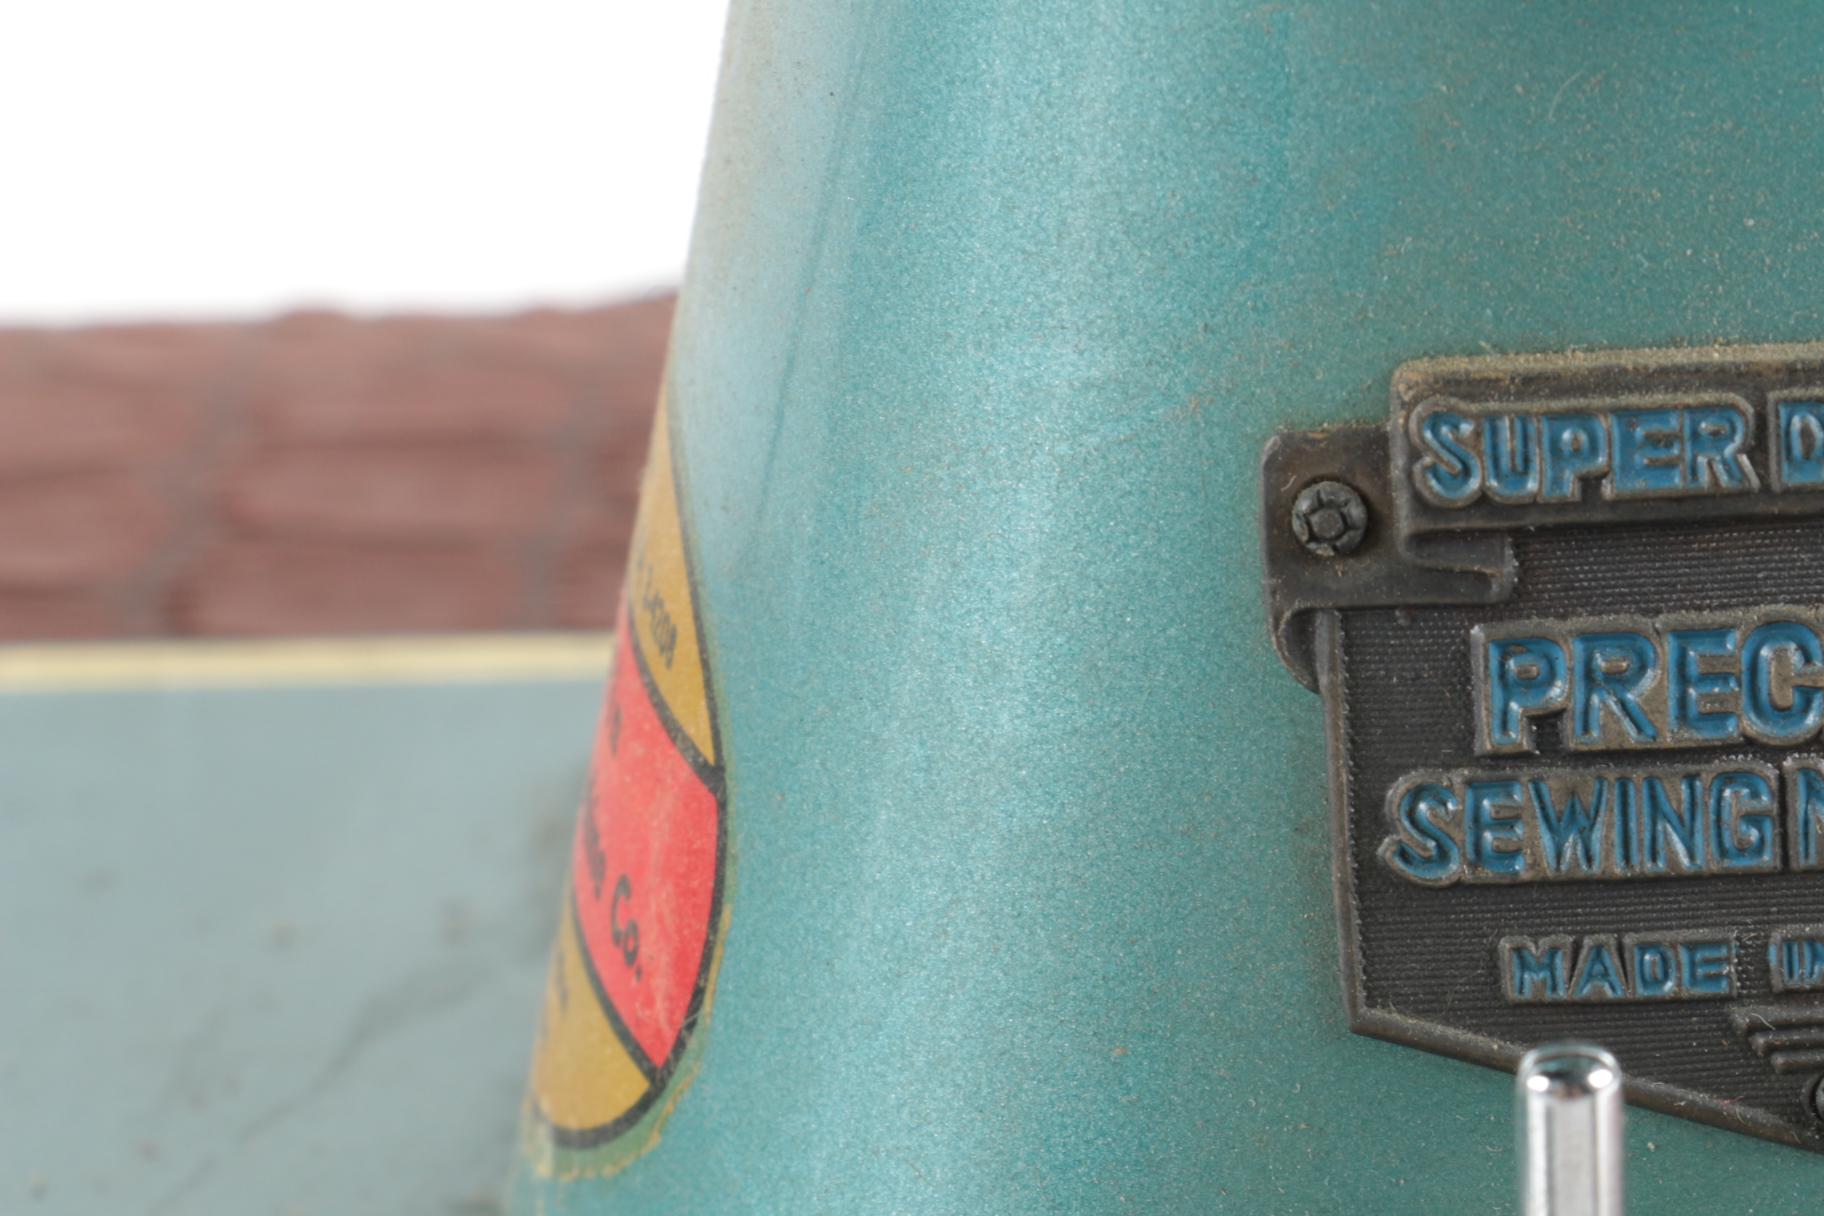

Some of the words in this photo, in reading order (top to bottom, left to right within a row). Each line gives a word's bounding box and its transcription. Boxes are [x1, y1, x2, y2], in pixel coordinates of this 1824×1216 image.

[1417, 395, 1762, 504] SUPER
[1391, 770, 1776, 880] SEWING
[1511, 936, 1733, 1000] MADE
